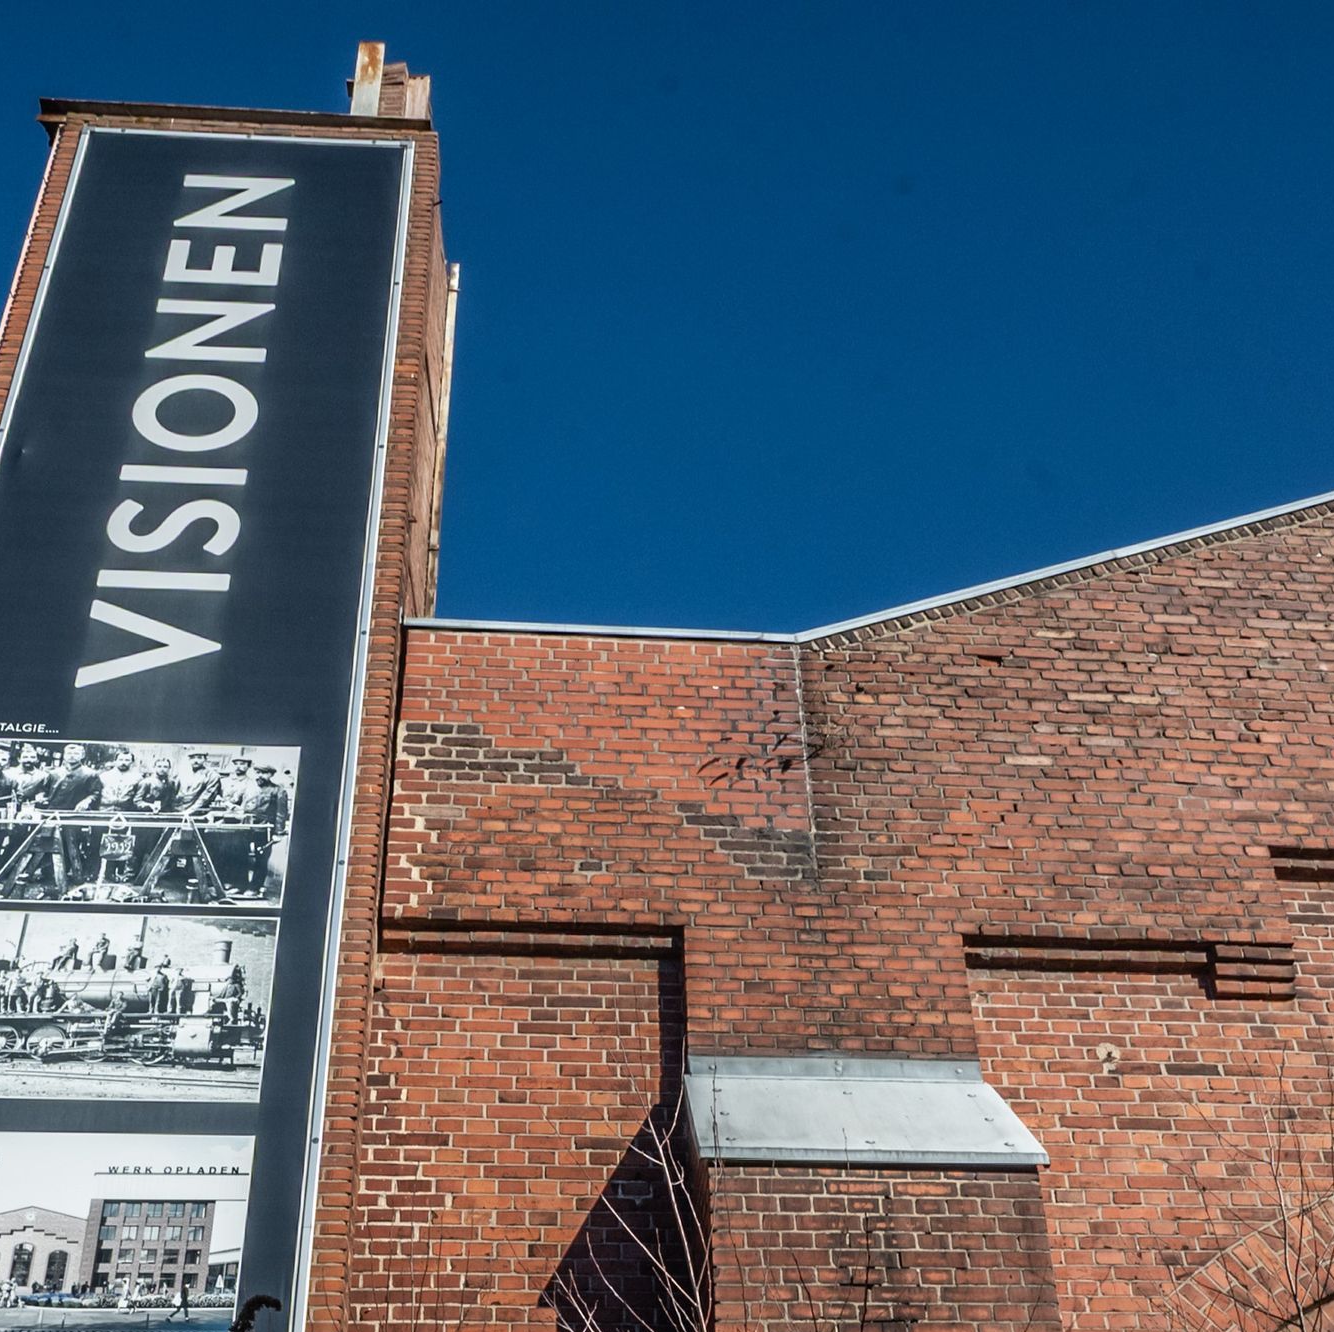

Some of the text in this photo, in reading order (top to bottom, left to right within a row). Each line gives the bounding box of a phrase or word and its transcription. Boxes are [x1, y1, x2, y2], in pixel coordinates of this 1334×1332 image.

[74, 174, 296, 689] VISIONEN
[108, 1166, 240, 1175] WERK OPLADEN
